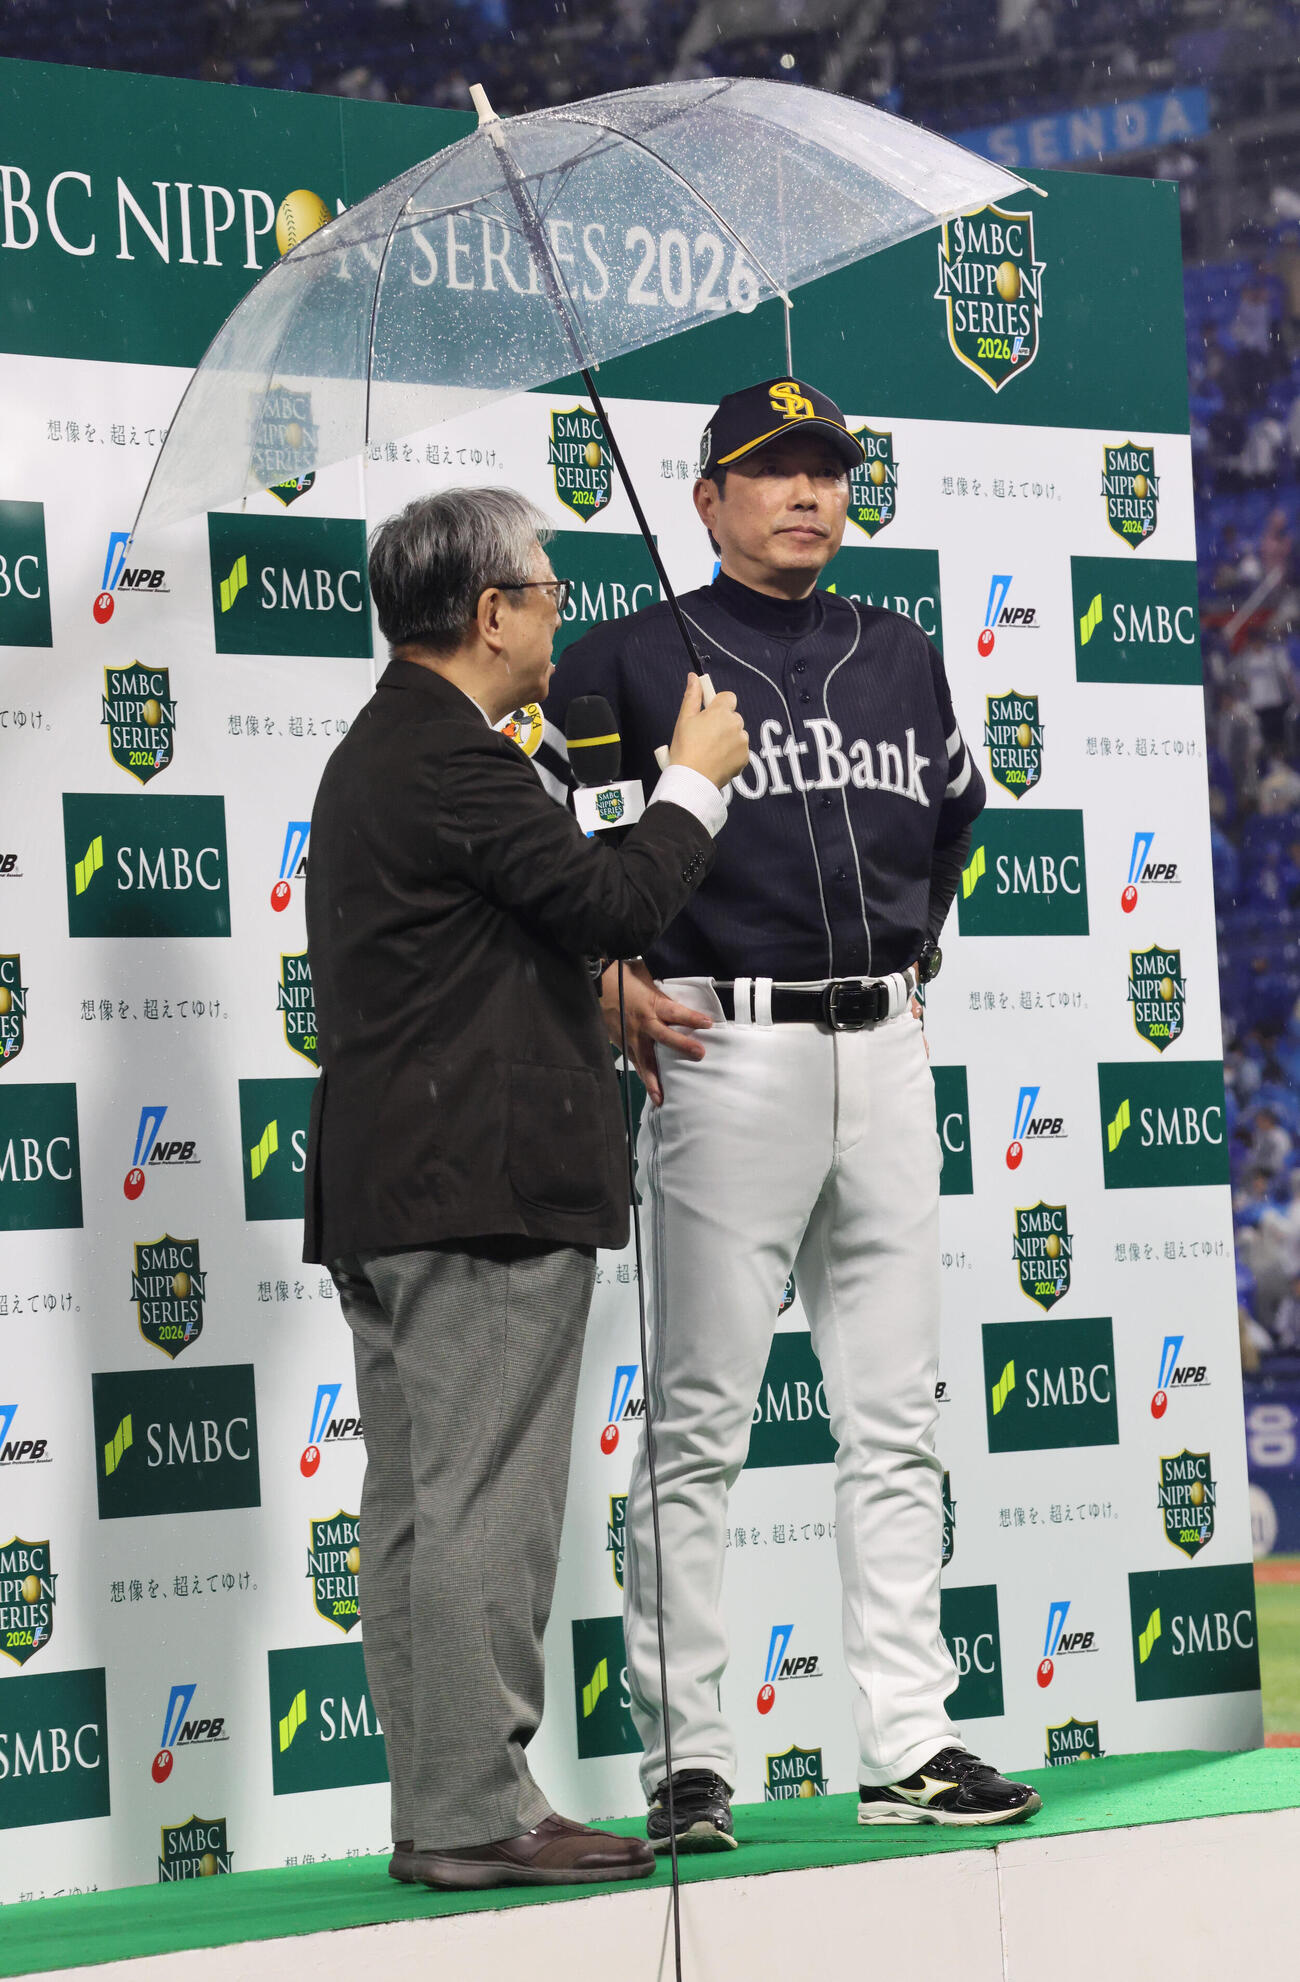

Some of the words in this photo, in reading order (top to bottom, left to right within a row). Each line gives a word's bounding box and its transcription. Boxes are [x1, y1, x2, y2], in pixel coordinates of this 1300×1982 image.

[954, 219, 1024, 257] SMBC
[624, 225, 760, 314] 2026
[954, 299, 1031, 337] SERIES
[976, 337, 1012, 360] 2026
[254, 397, 306, 420] MBC
[556, 416, 604, 440] SMBC
[1108, 450, 1150, 473] SMBC
[557, 466, 608, 490] SERIES
[572, 490, 595, 505] 2026
[850, 485, 893, 508] ERIES
[858, 507, 880, 521] 2026
[1109, 497, 1154, 520] SERIES
[1122, 519, 1143, 533] 2026
[119, 568, 166, 588] NPB
[260, 566, 363, 613] SMBC
[999, 607, 1036, 625] NPB
[1112, 603, 1195, 645] SMBC
[111, 673, 164, 697] SMBC
[991, 700, 1034, 722] SMBC
[112, 726, 170, 750] SERIES
[129, 750, 154, 766] 2026
[721, 717, 931, 808] oftBank
[992, 747, 1039, 769] SERIES
[1005, 769, 1027, 784] 2026
[116, 846, 222, 891] SMBC
[995, 855, 1081, 895] SMBC
[1142, 863, 1178, 880] NPB
[1135, 955, 1176, 976] SMBC
[1136, 1001, 1181, 1023] SERIES
[1149, 1023, 1170, 1037] 2026
[1026, 1117, 1064, 1135] NPB
[1140, 1105, 1223, 1147] SMBC
[150, 1141, 196, 1161] NPB
[1020, 1211, 1063, 1233] SMBC
[141, 1246, 193, 1271] SMBC
[1021, 1258, 1067, 1281] SERIES
[1034, 1281, 1056, 1295] 2026
[142, 1300, 199, 1325] SERIES
[158, 1325, 184, 1341] 2026
[1025, 1364, 1111, 1408] SMBC
[1169, 1365, 1207, 1384] NPB
[146, 1417, 251, 1468] SMBC
[1165, 1459, 1207, 1481] SMBC
[1166, 1506, 1212, 1529] SERIES
[1179, 1529, 1200, 1543] 2026
[332, 1599, 358, 1616] 2026
[6, 1630, 33, 1647] 2026
[1057, 1631, 1095, 1651] NPB
[1170, 1610, 1254, 1656] SMBC
[778, 1655, 819, 1677] NPB
[179, 1717, 225, 1742] NPB
[320, 1694, 384, 1742] SM
[1052, 1727, 1095, 1752] SMBC
[772, 1755, 817, 1780] SMBC
[168, 1826, 220, 1855] SMBC
